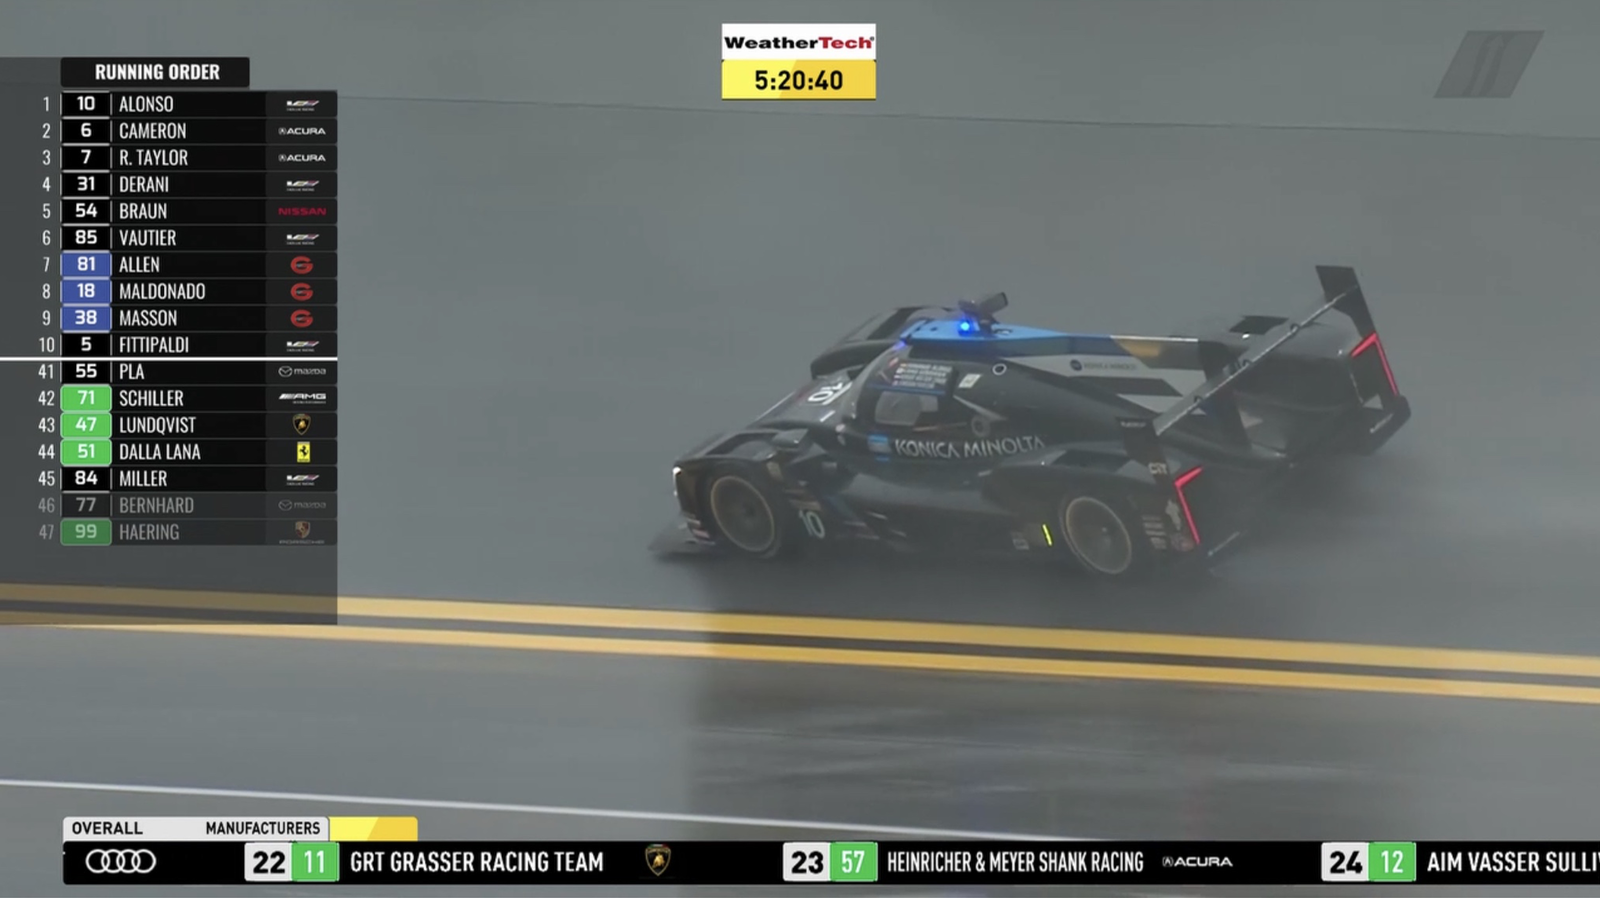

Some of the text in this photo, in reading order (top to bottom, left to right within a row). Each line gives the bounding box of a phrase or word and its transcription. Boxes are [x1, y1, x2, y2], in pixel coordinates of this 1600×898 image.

[895, 435, 1046, 459] KONICA MINOLTA
[799, 509, 826, 540] 10
